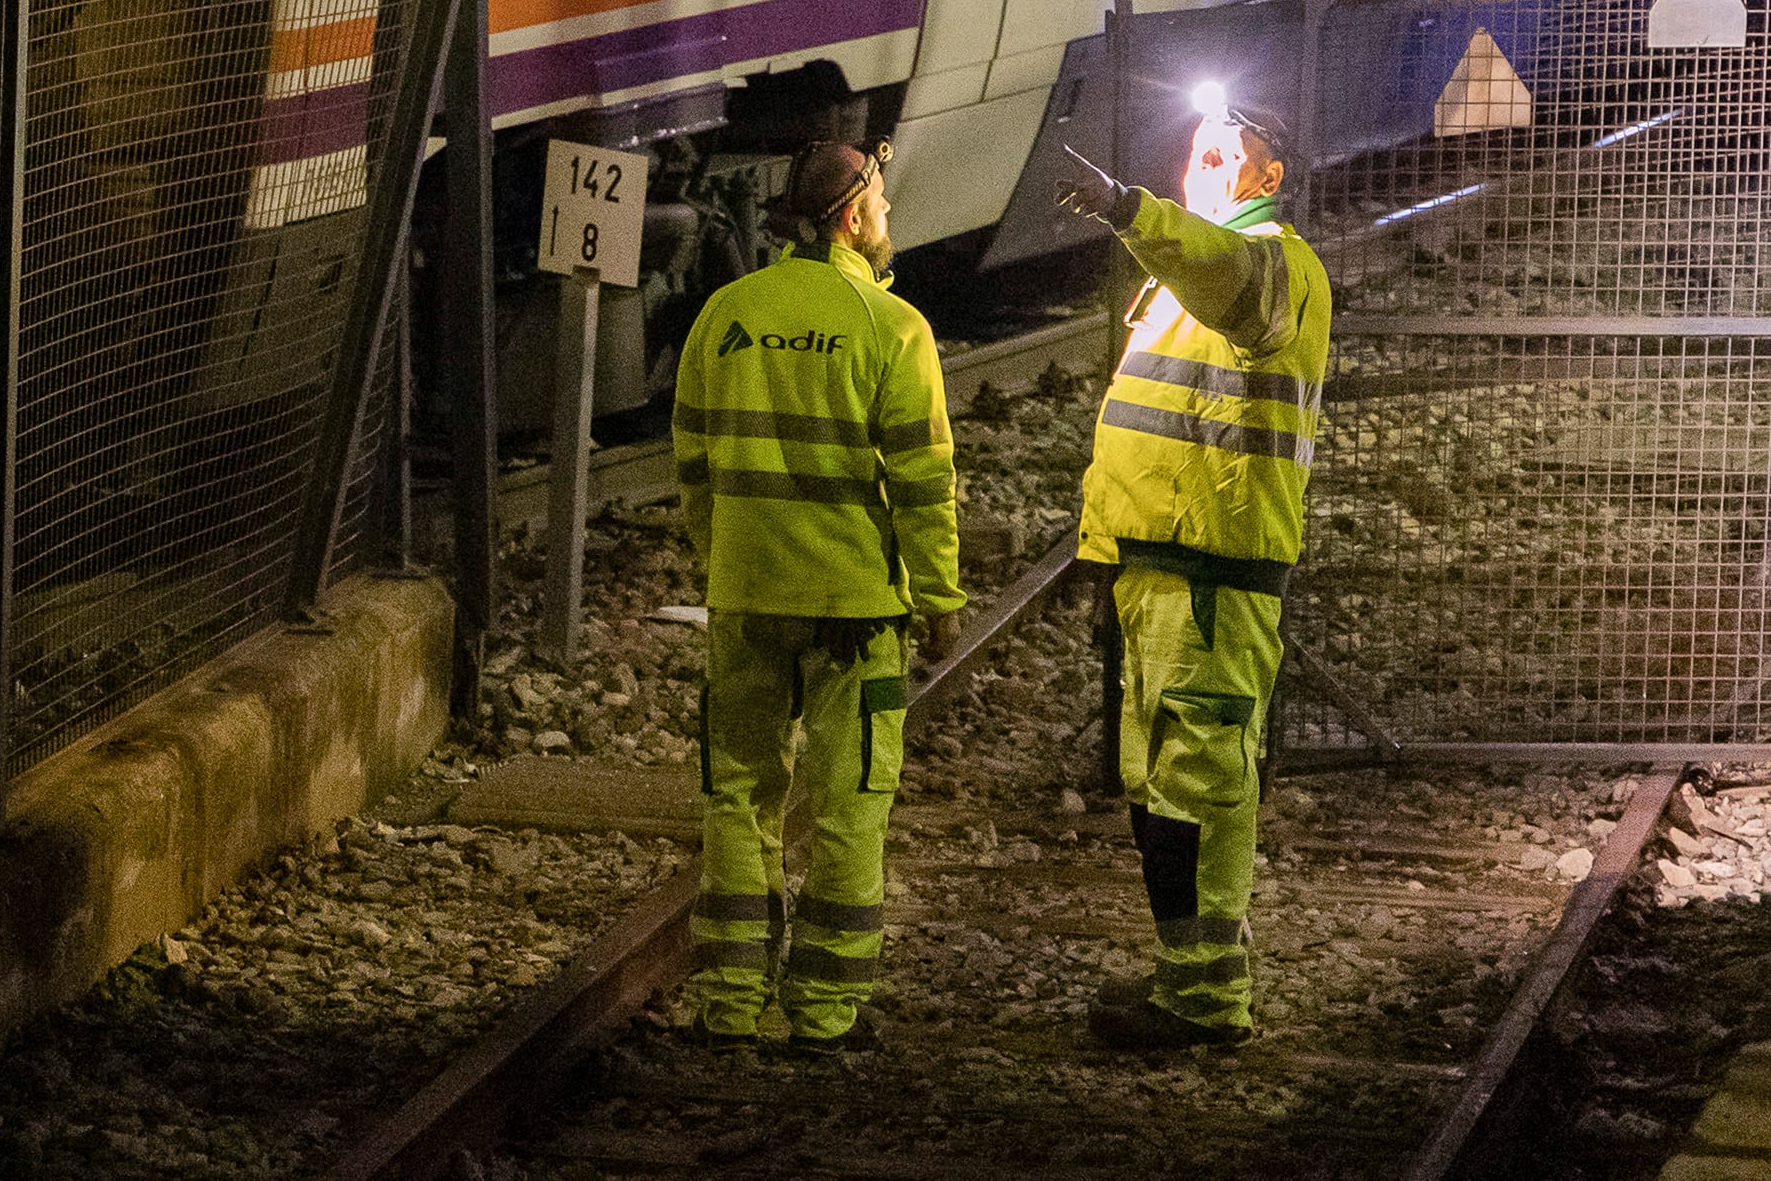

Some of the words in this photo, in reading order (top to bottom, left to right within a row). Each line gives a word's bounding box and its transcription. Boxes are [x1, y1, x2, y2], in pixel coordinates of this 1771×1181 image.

[571, 155, 623, 203] 142
[581, 223, 599, 262] 8
[759, 329, 847, 356] adif
